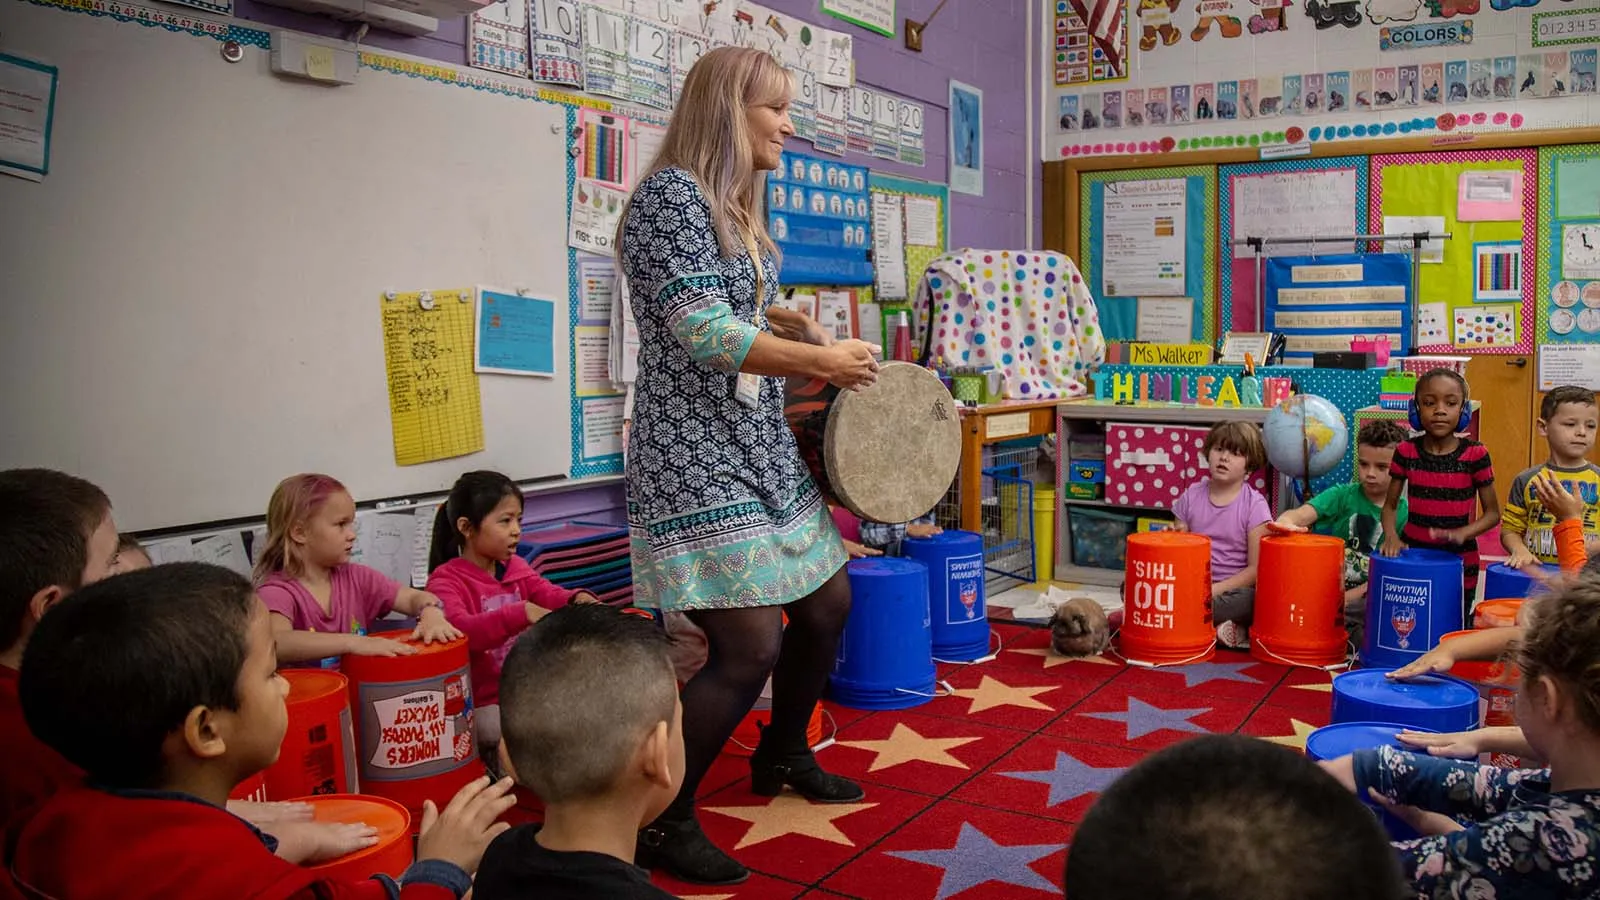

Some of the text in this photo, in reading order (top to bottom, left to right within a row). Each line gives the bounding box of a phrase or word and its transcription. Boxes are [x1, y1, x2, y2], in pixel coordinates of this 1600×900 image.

[1203, 1, 1229, 12] orange
[94, 2, 105, 11] 41
[109, 5, 121, 15] 42
[124, 8, 136, 17] 43
[138, 11, 150, 21] 44
[152, 14, 164, 23] 45
[166, 17, 178, 26] 46
[180, 20, 191, 29] 47
[194, 22, 205, 31] 48
[206, 24, 217, 33] 49
[542, 0, 572, 36] 10
[483, 29, 502, 41] nine
[595, 15, 618, 50] 11
[635, 24, 665, 60] 12
[1391, 27, 1457, 44] COLORS
[545, 43, 561, 53] ten
[827, 57, 847, 78] Zz
[1105, 94, 1120, 104] Cc
[1174, 87, 1186, 98] Ff
[1219, 84, 1236, 95] Hh
[1284, 78, 1301, 89] Kk
[1327, 75, 1349, 85] Mm
[1400, 68, 1417, 81] Pp
[1448, 65, 1464, 75] Rr
[1571, 53, 1596, 65] Ww
[819, 86, 839, 113] 17
[852, 88, 871, 115] 18
[879, 100, 896, 123] 19
[903, 105, 921, 129] 20
[594, 235, 608, 247] to
[1135, 345, 1203, 365] Ms Walker
[951, 568, 982, 580] SHERWIN
[1133, 559, 1177, 580] THIS.
[1133, 581, 1174, 612] DO
[1384, 592, 1427, 607] SHERWIN
[1133, 613, 1174, 629] LET'S
[394, 703, 440, 725] BUCKET
